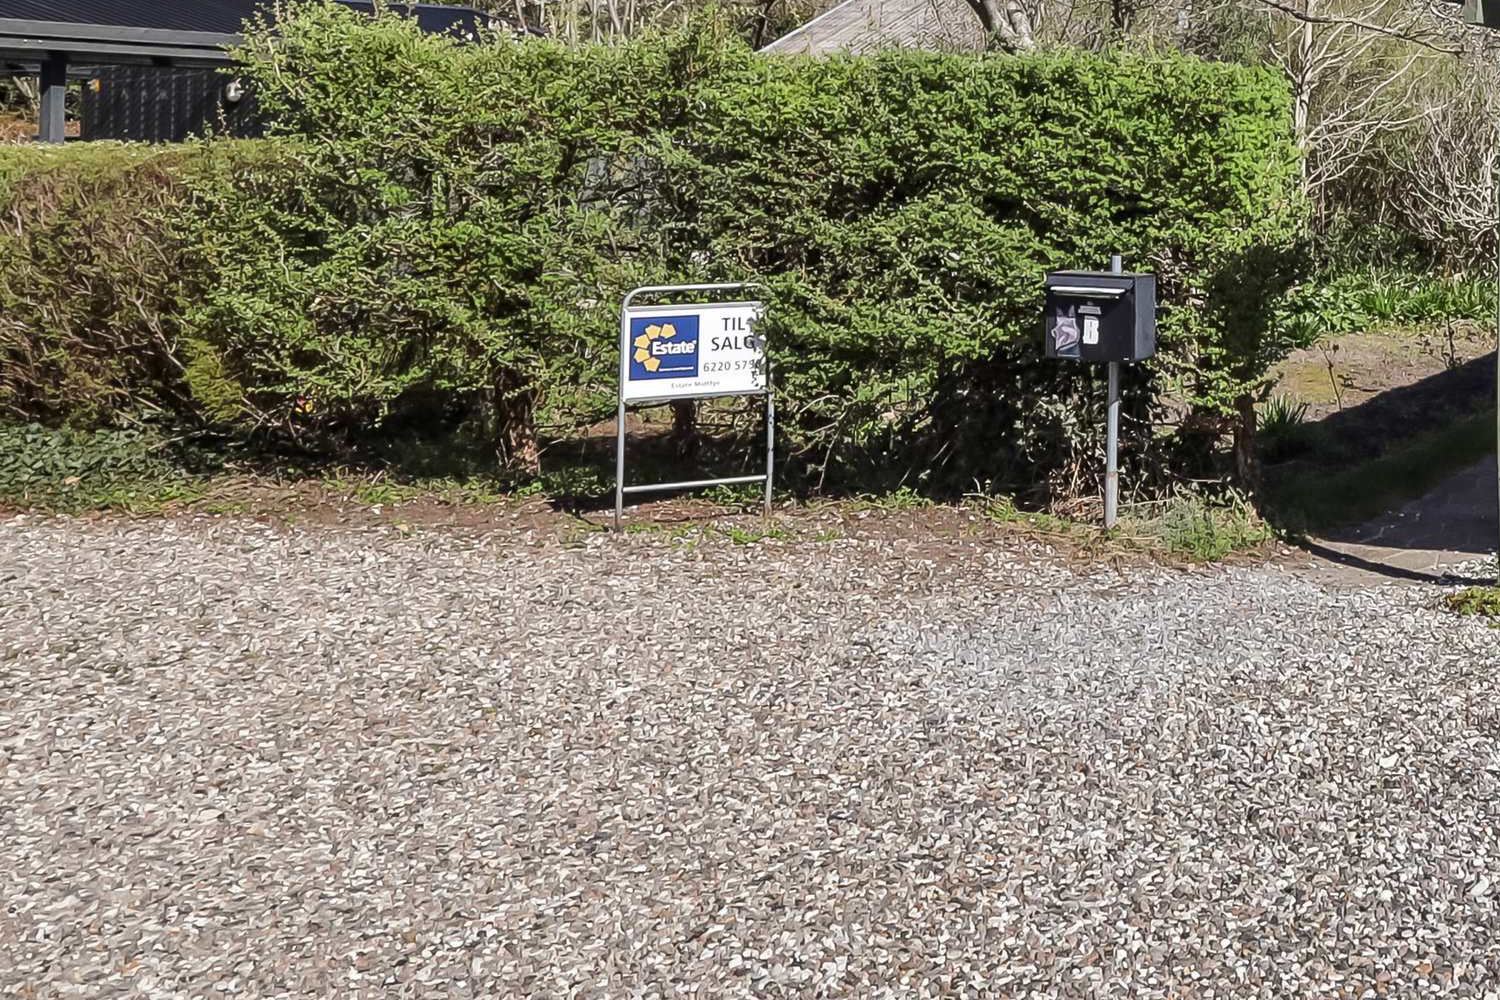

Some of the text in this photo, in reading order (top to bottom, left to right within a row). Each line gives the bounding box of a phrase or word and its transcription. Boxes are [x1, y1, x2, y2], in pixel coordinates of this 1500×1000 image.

[721, 316, 746, 331] TIL
[652, 341, 696, 356] Estate
[711, 334, 755, 352] SALG
[703, 361, 731, 372] 6220
